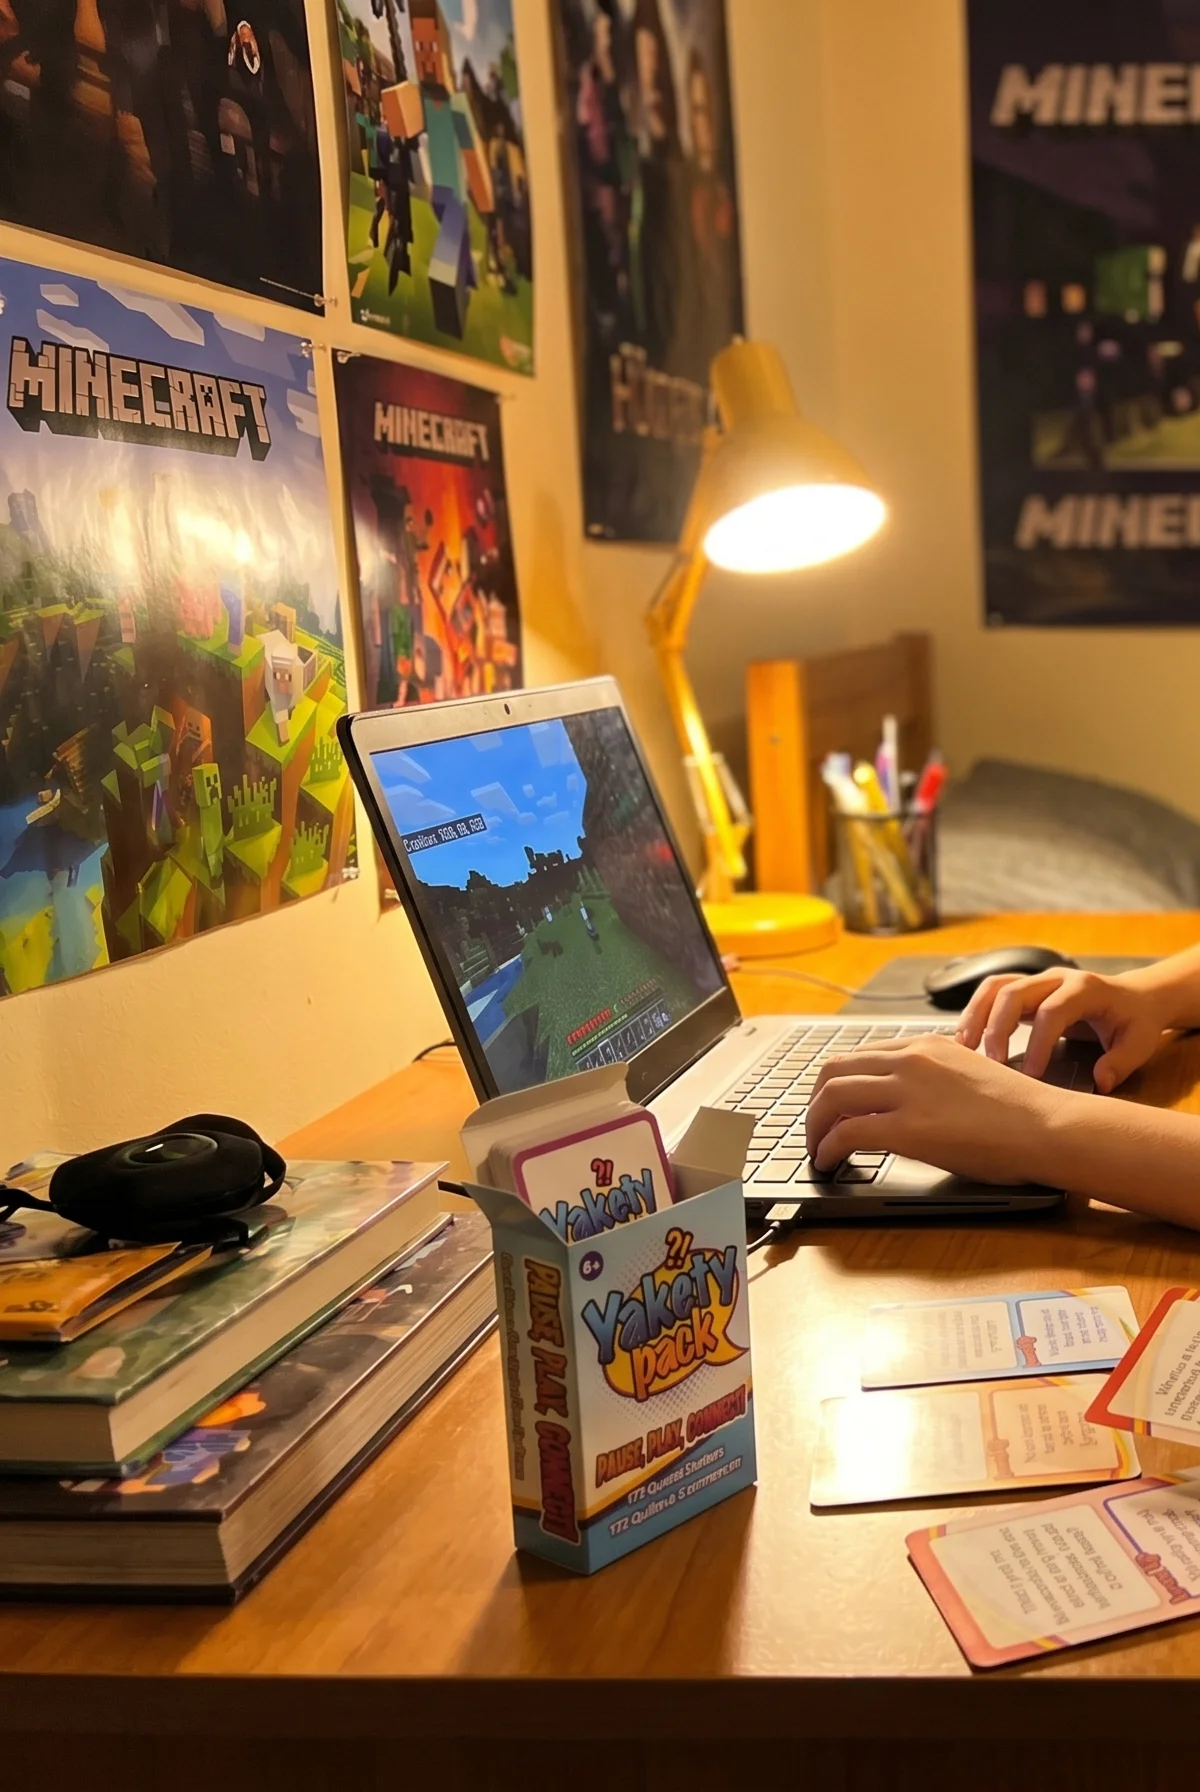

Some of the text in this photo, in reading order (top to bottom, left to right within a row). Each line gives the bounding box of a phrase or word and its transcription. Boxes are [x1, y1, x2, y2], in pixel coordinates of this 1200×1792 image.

[7, 336, 271, 455] MINECRAFT
[373, 400, 490, 462] MINECRAFT
[539, 1168, 657, 1244] Yakety
[582, 1258, 601, 1275] 6+
[581, 1245, 738, 1365] Yakety
[629, 1307, 719, 1403] pack
[595, 1436, 646, 1489] PAUSE,
